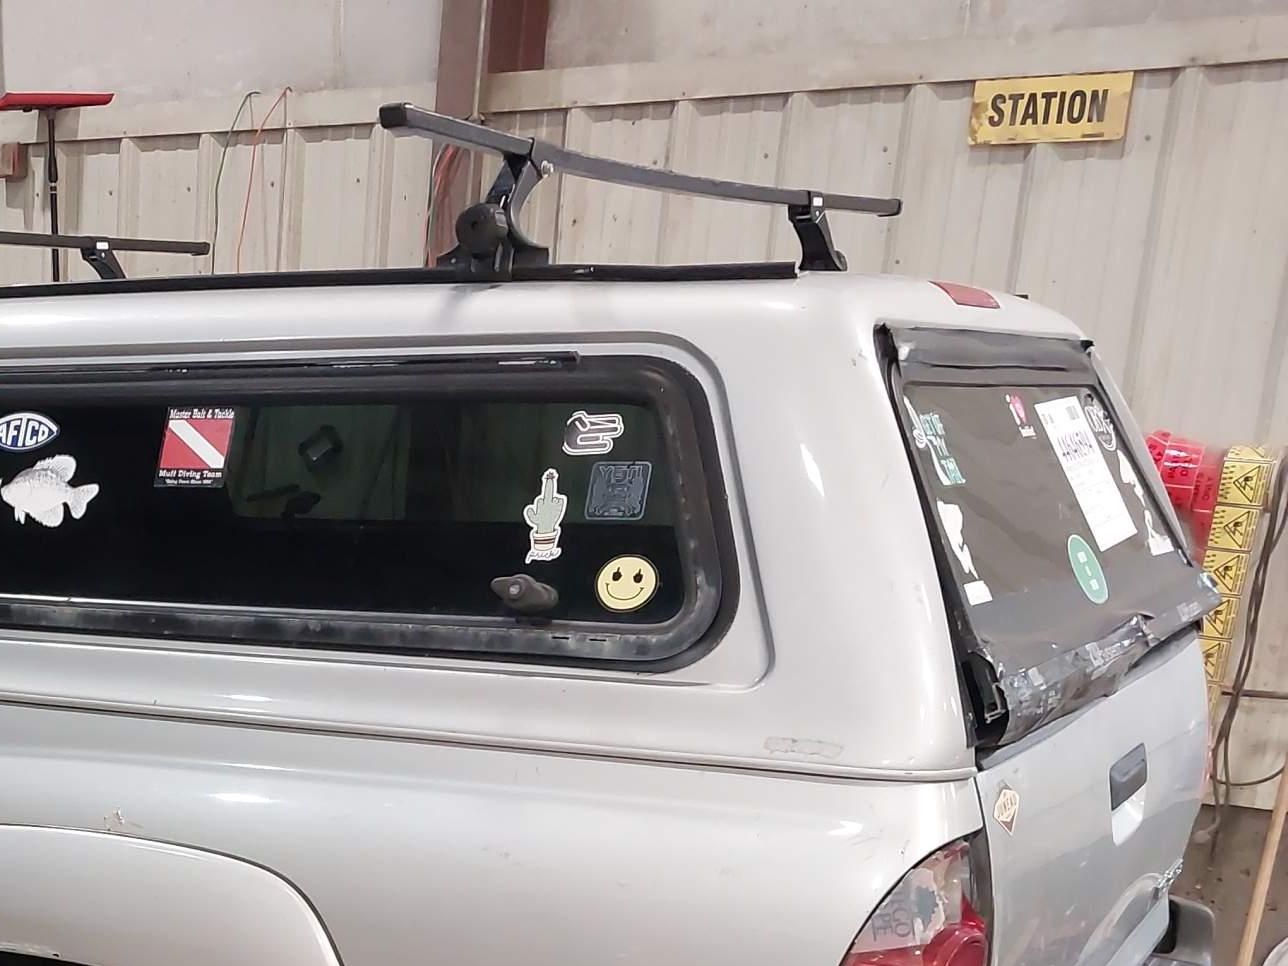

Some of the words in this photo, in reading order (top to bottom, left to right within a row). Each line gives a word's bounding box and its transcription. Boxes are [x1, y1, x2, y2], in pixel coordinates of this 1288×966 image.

[988, 89, 1109, 127] STATION
[214, 407, 235, 419] Tackle
[203, 470, 223, 478] Team
